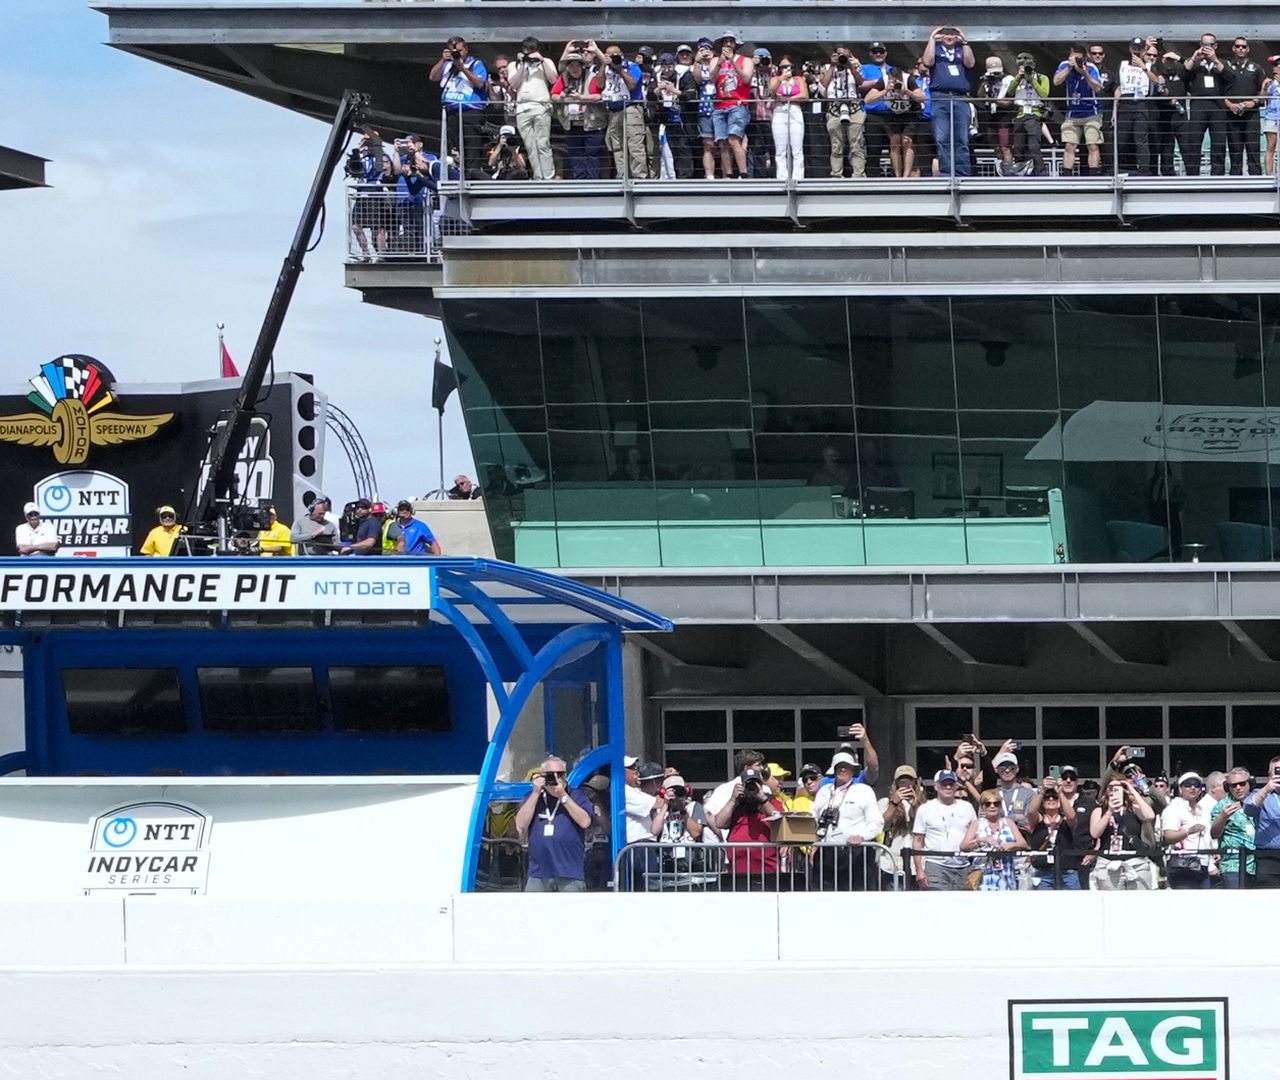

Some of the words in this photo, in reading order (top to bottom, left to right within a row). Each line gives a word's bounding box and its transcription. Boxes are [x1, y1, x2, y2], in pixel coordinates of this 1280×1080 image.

[73, 407, 84, 457] MOTOR
[96, 424, 147, 435] SPEEDWAY
[78, 490, 120, 506] NTT
[43, 518, 130, 535] NDYCAR
[234, 574, 297, 603] PIT
[143, 824, 195, 840] NTT
[87, 856, 199, 873] INDYCAR
[108, 874, 172, 885] SERIES
[1031, 1015, 1205, 1067] TAG
